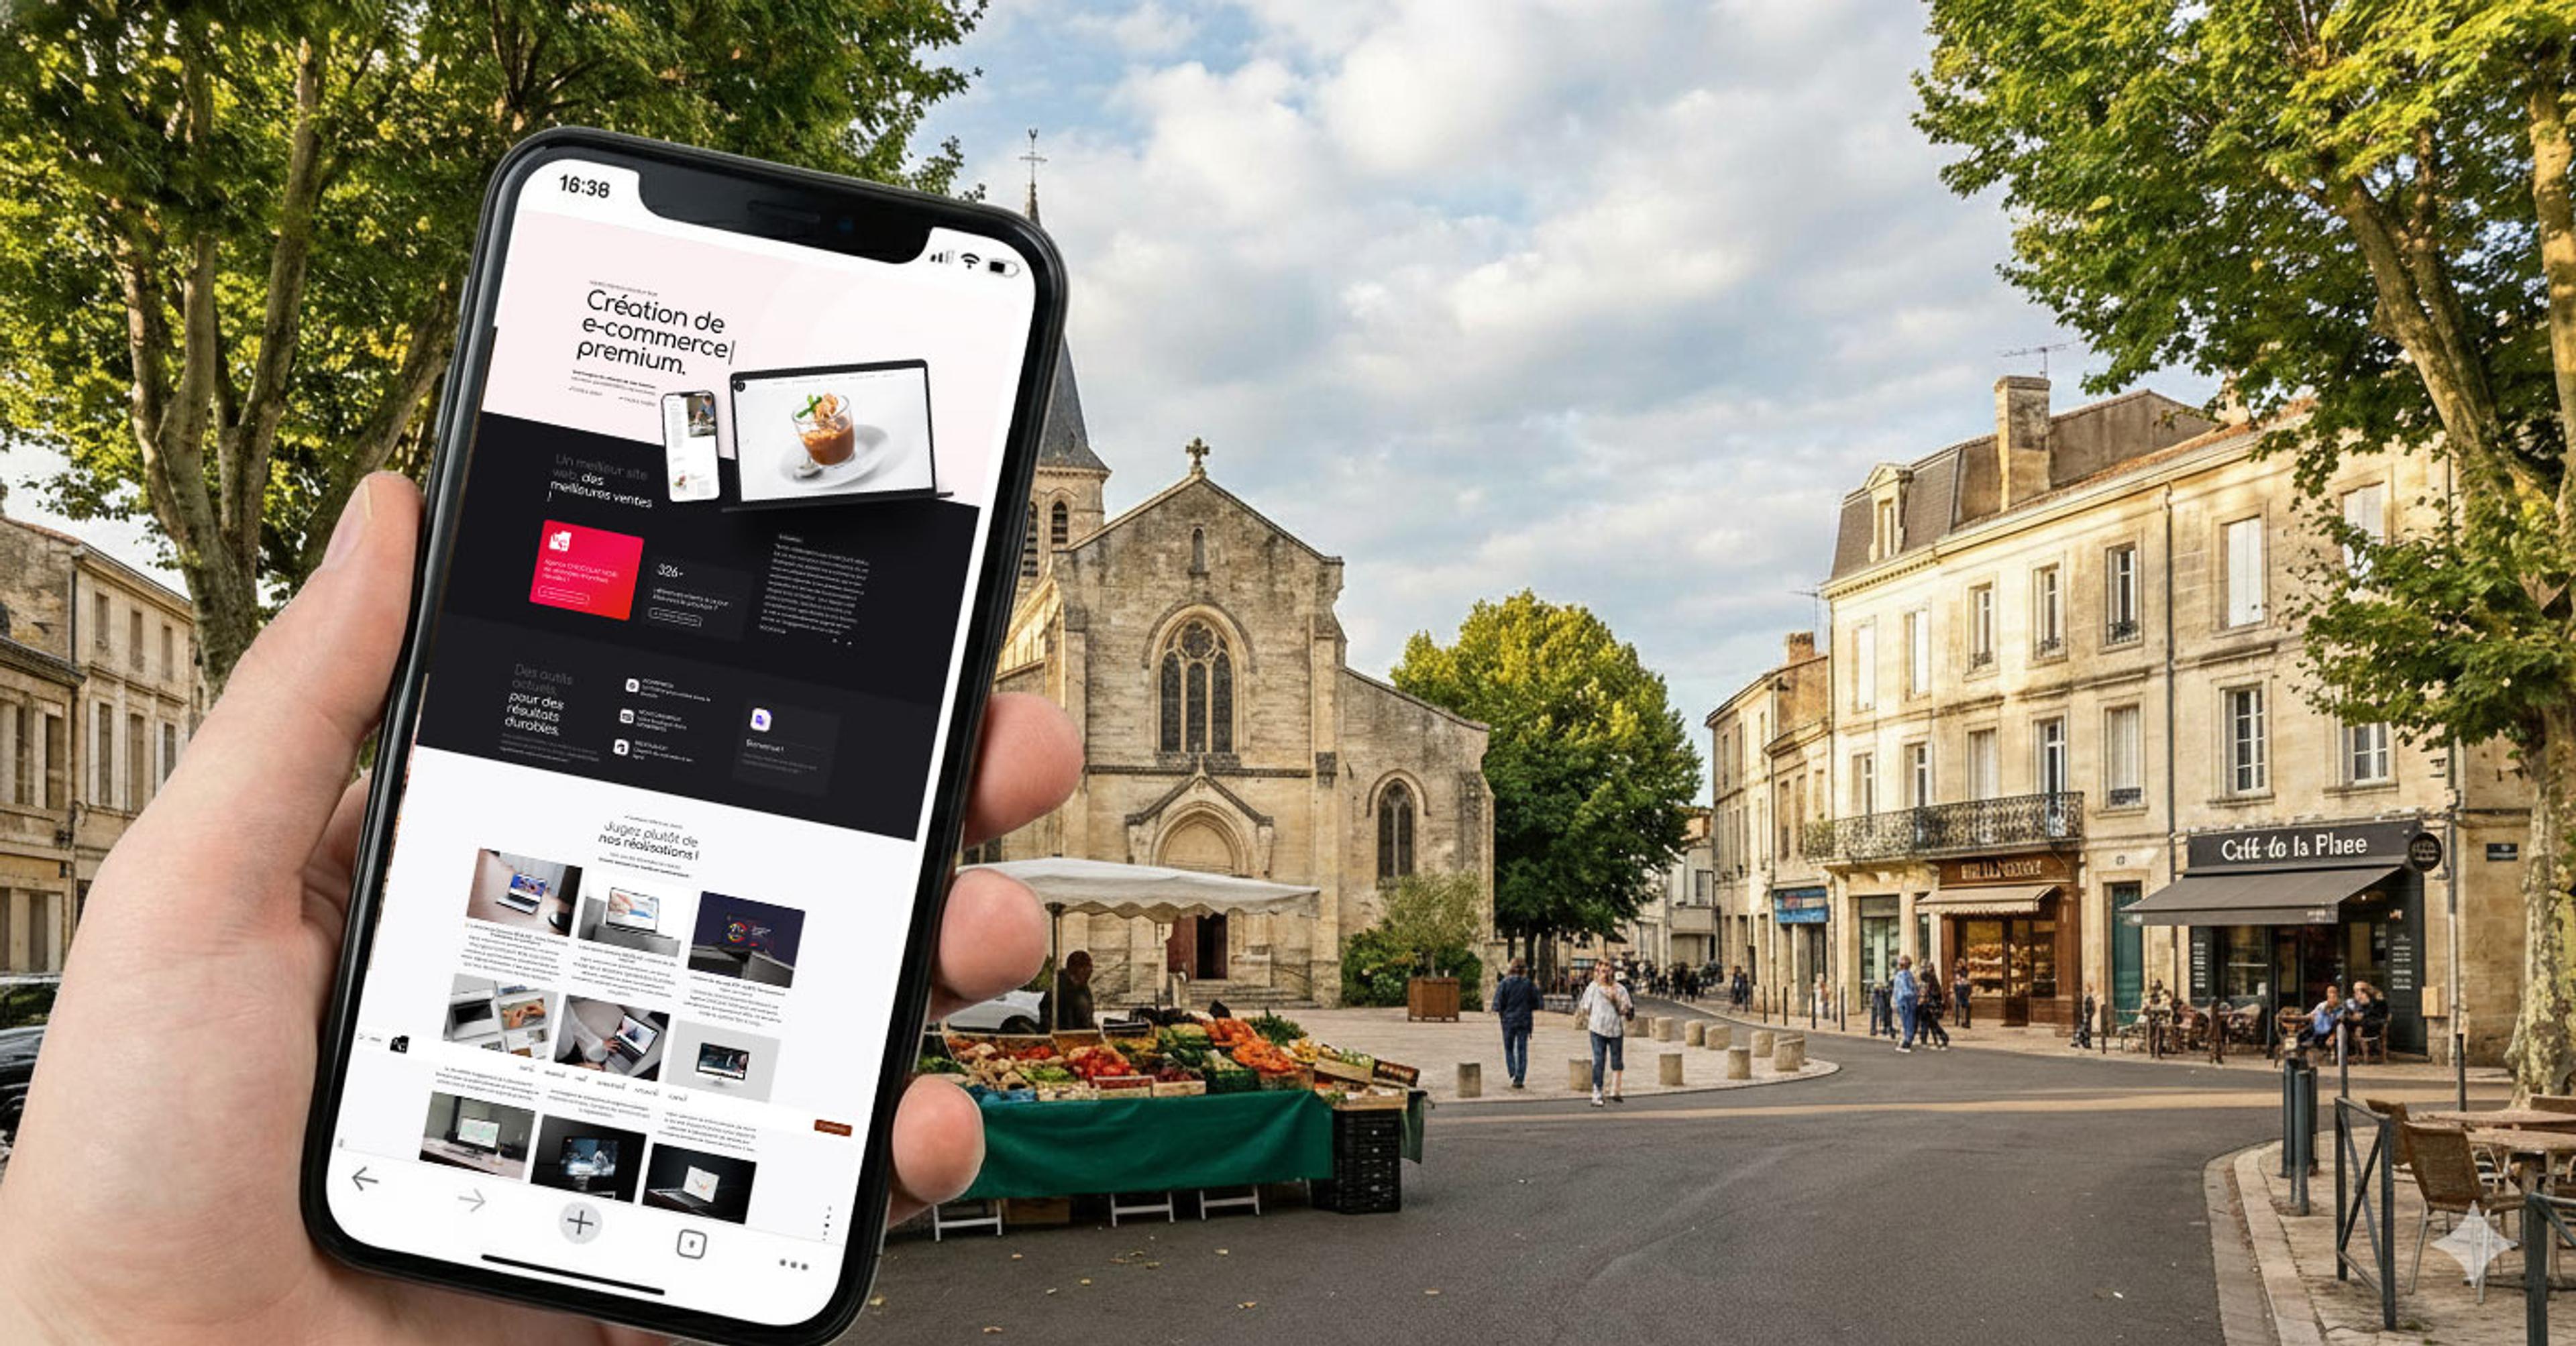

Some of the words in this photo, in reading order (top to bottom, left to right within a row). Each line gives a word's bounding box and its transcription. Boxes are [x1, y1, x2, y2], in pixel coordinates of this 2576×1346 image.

[559, 174, 610, 199] 16:38
[587, 288, 688, 327] Création
[694, 311, 725, 334] de
[576, 341, 686, 376] premium.
[582, 471, 604, 486] des
[550, 480, 611, 501] meilleures
[612, 493, 653, 508] ventes
[514, 663, 537, 678] Des
[539, 671, 573, 685] outils
[506, 703, 560, 723] résultats
[508, 692, 540, 705] pour
[541, 697, 565, 710] des
[598, 834, 621, 847] nos
[623, 837, 693, 860] réalisations
[603, 821, 641, 837] Jugez
[642, 828, 680, 844] plutôt
[682, 835, 698, 848] de
[2293, 835, 2309, 857] la
